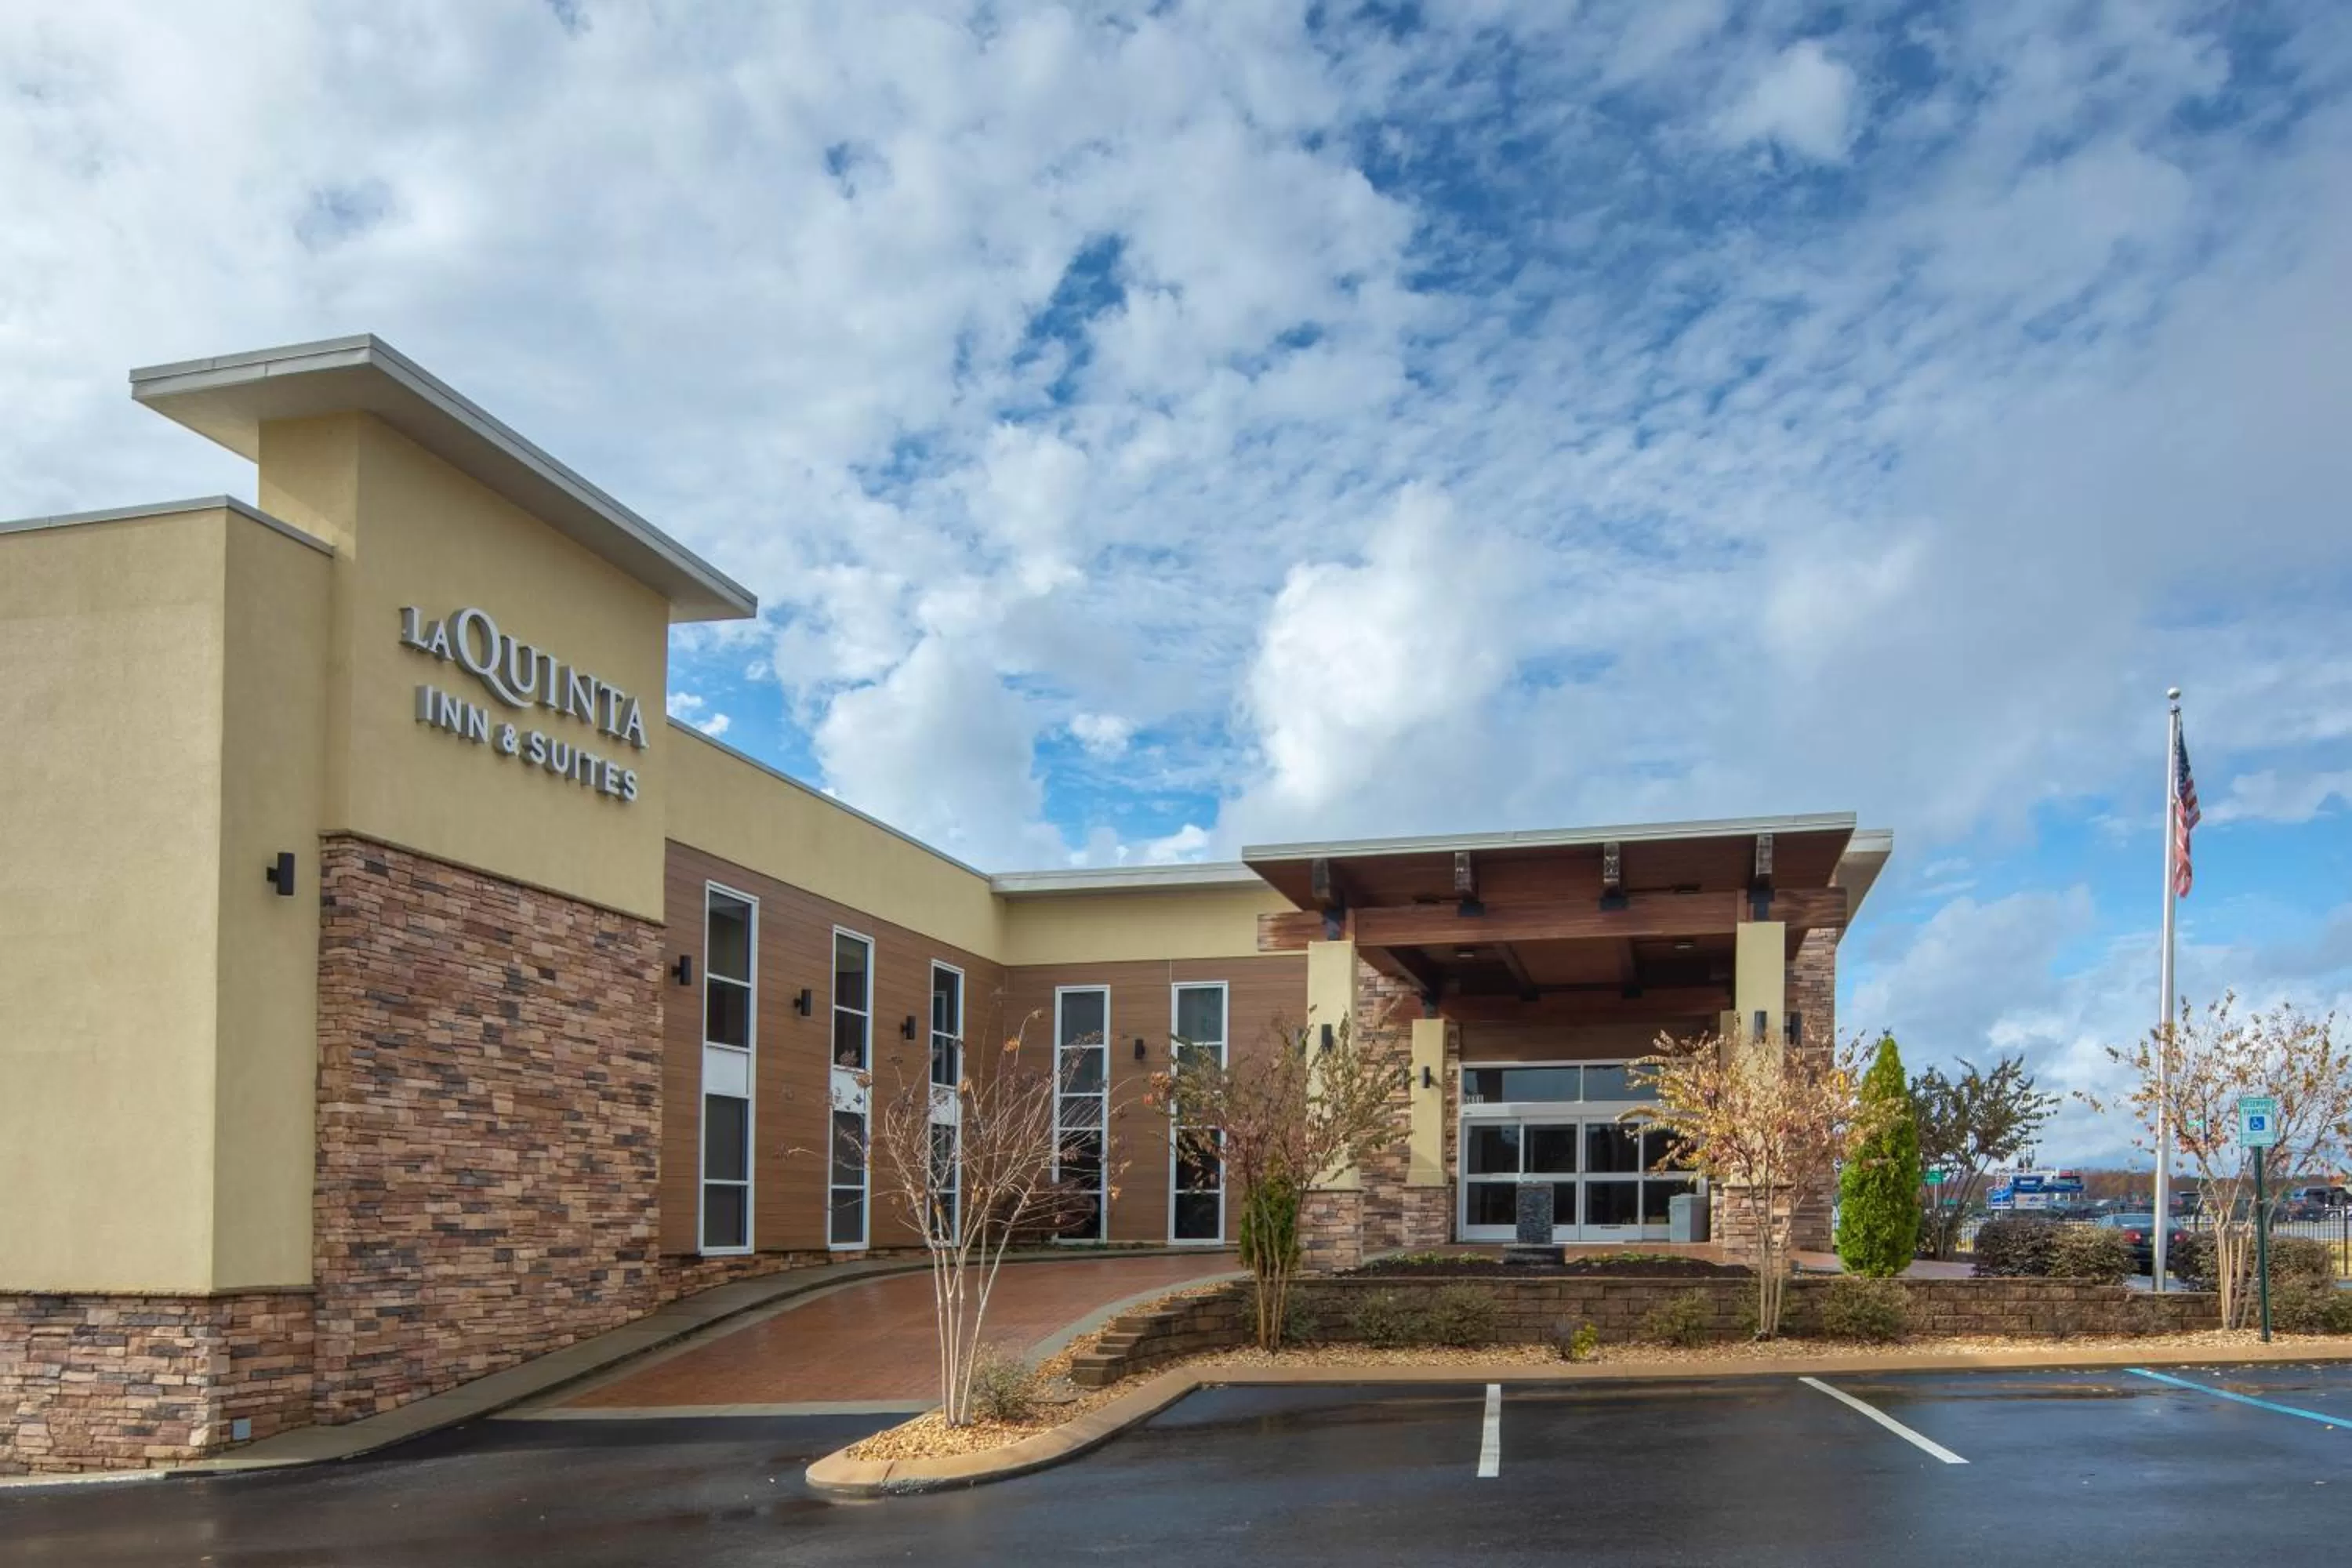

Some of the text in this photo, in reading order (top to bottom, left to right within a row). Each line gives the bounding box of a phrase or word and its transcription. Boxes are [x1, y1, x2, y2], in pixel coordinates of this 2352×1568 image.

[416, 685, 637, 801] INN & SUITES
